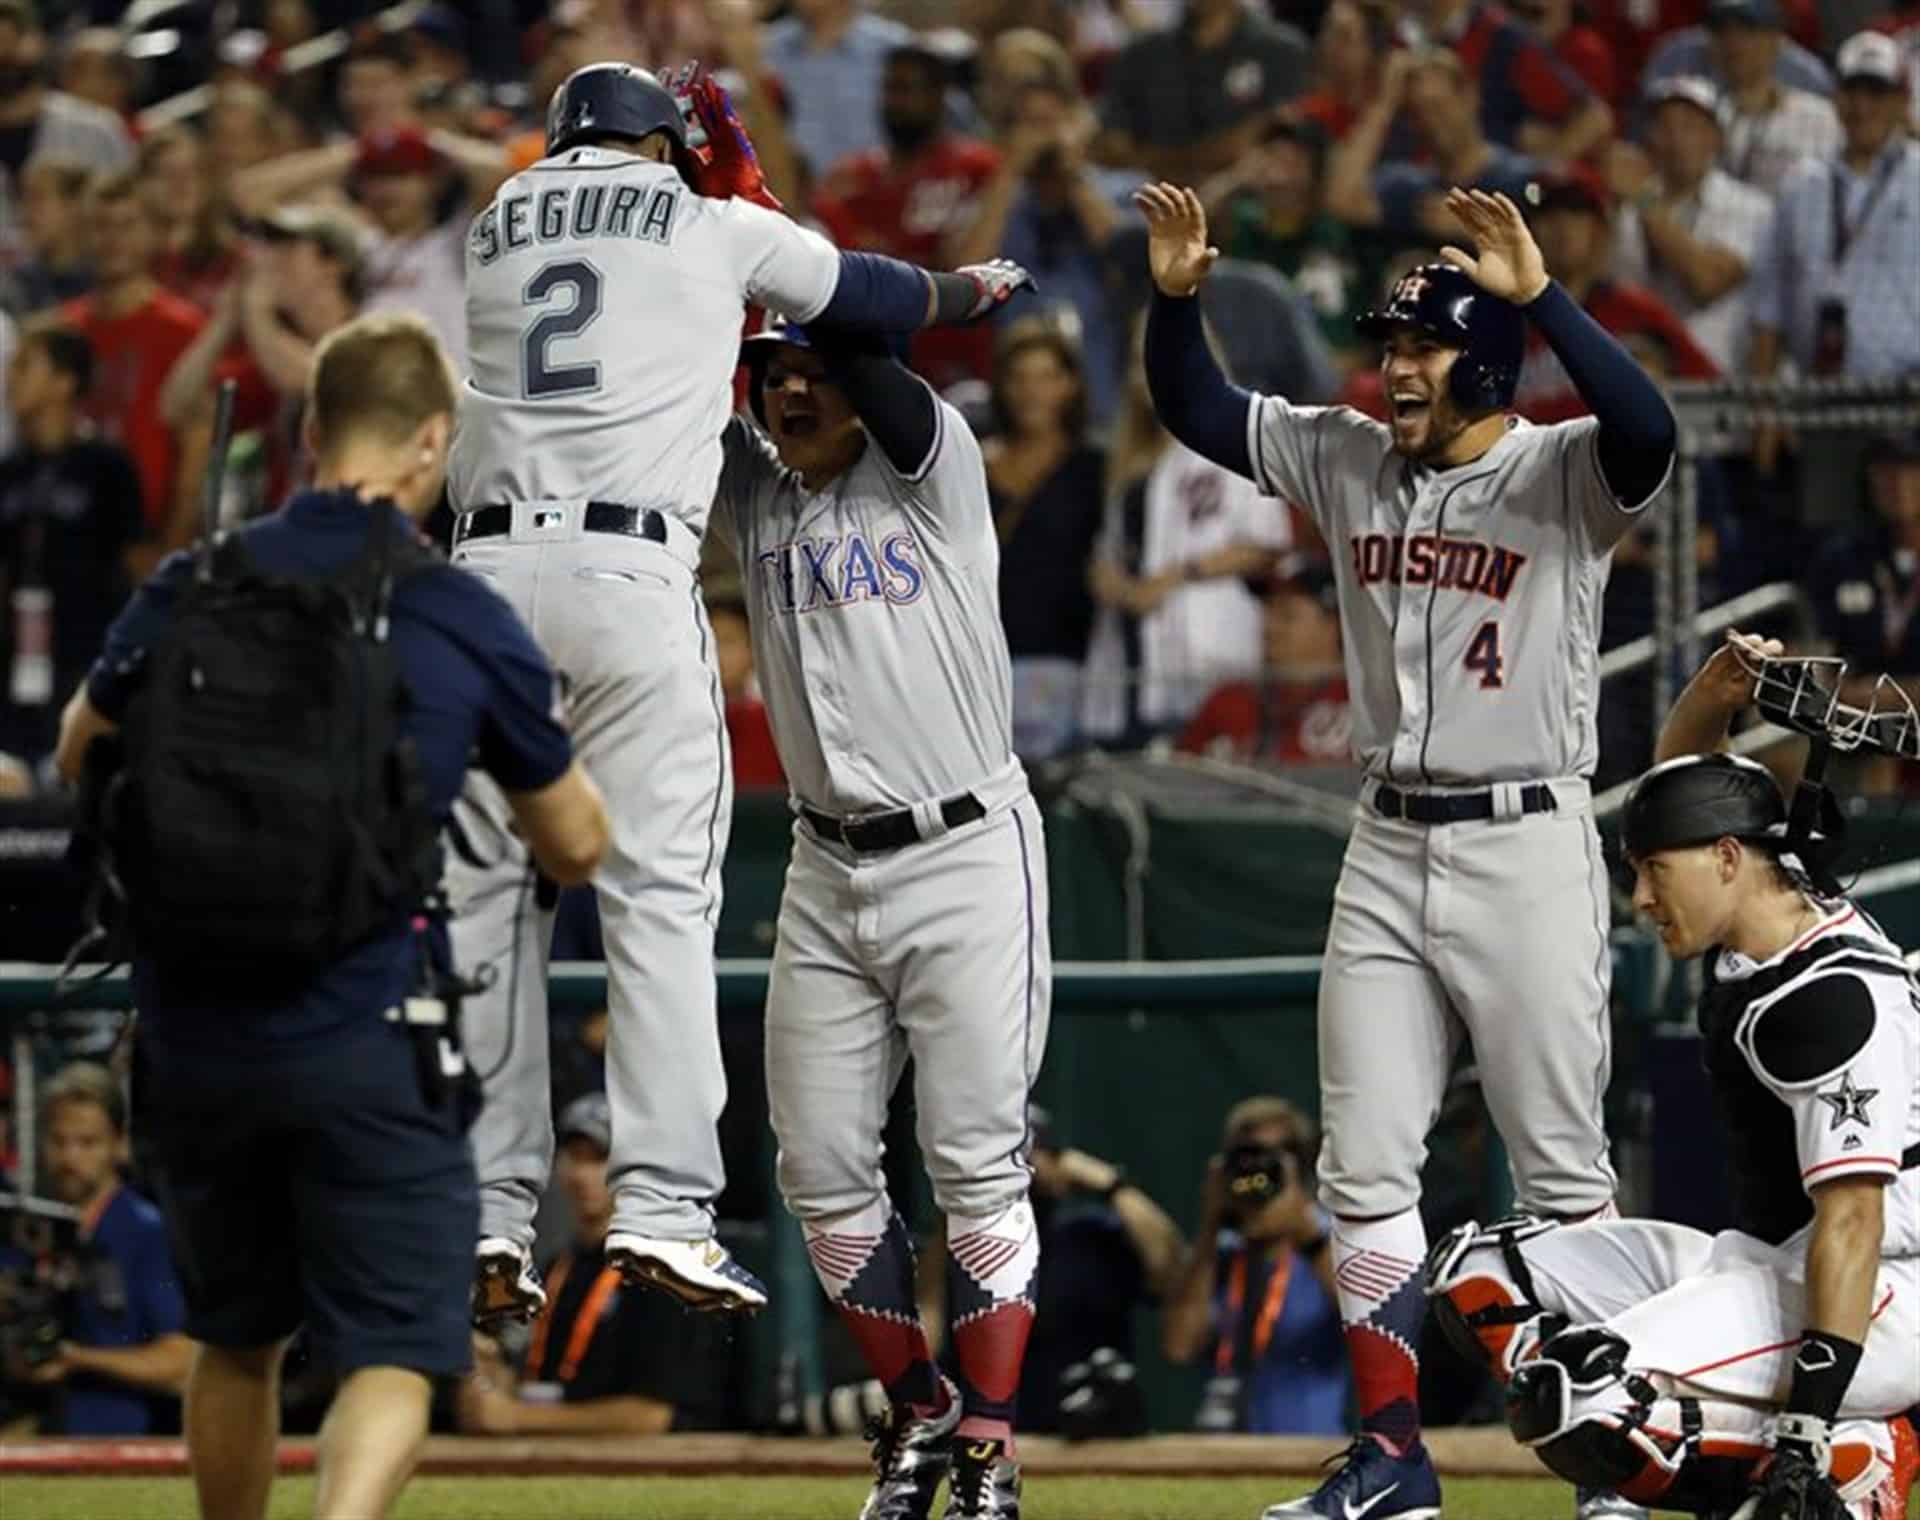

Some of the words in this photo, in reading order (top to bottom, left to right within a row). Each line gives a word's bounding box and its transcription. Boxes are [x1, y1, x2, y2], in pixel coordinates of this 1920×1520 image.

[471, 183, 682, 267] SEGURA
[520, 256, 605, 400] 2
[1463, 620, 1504, 691] 4
